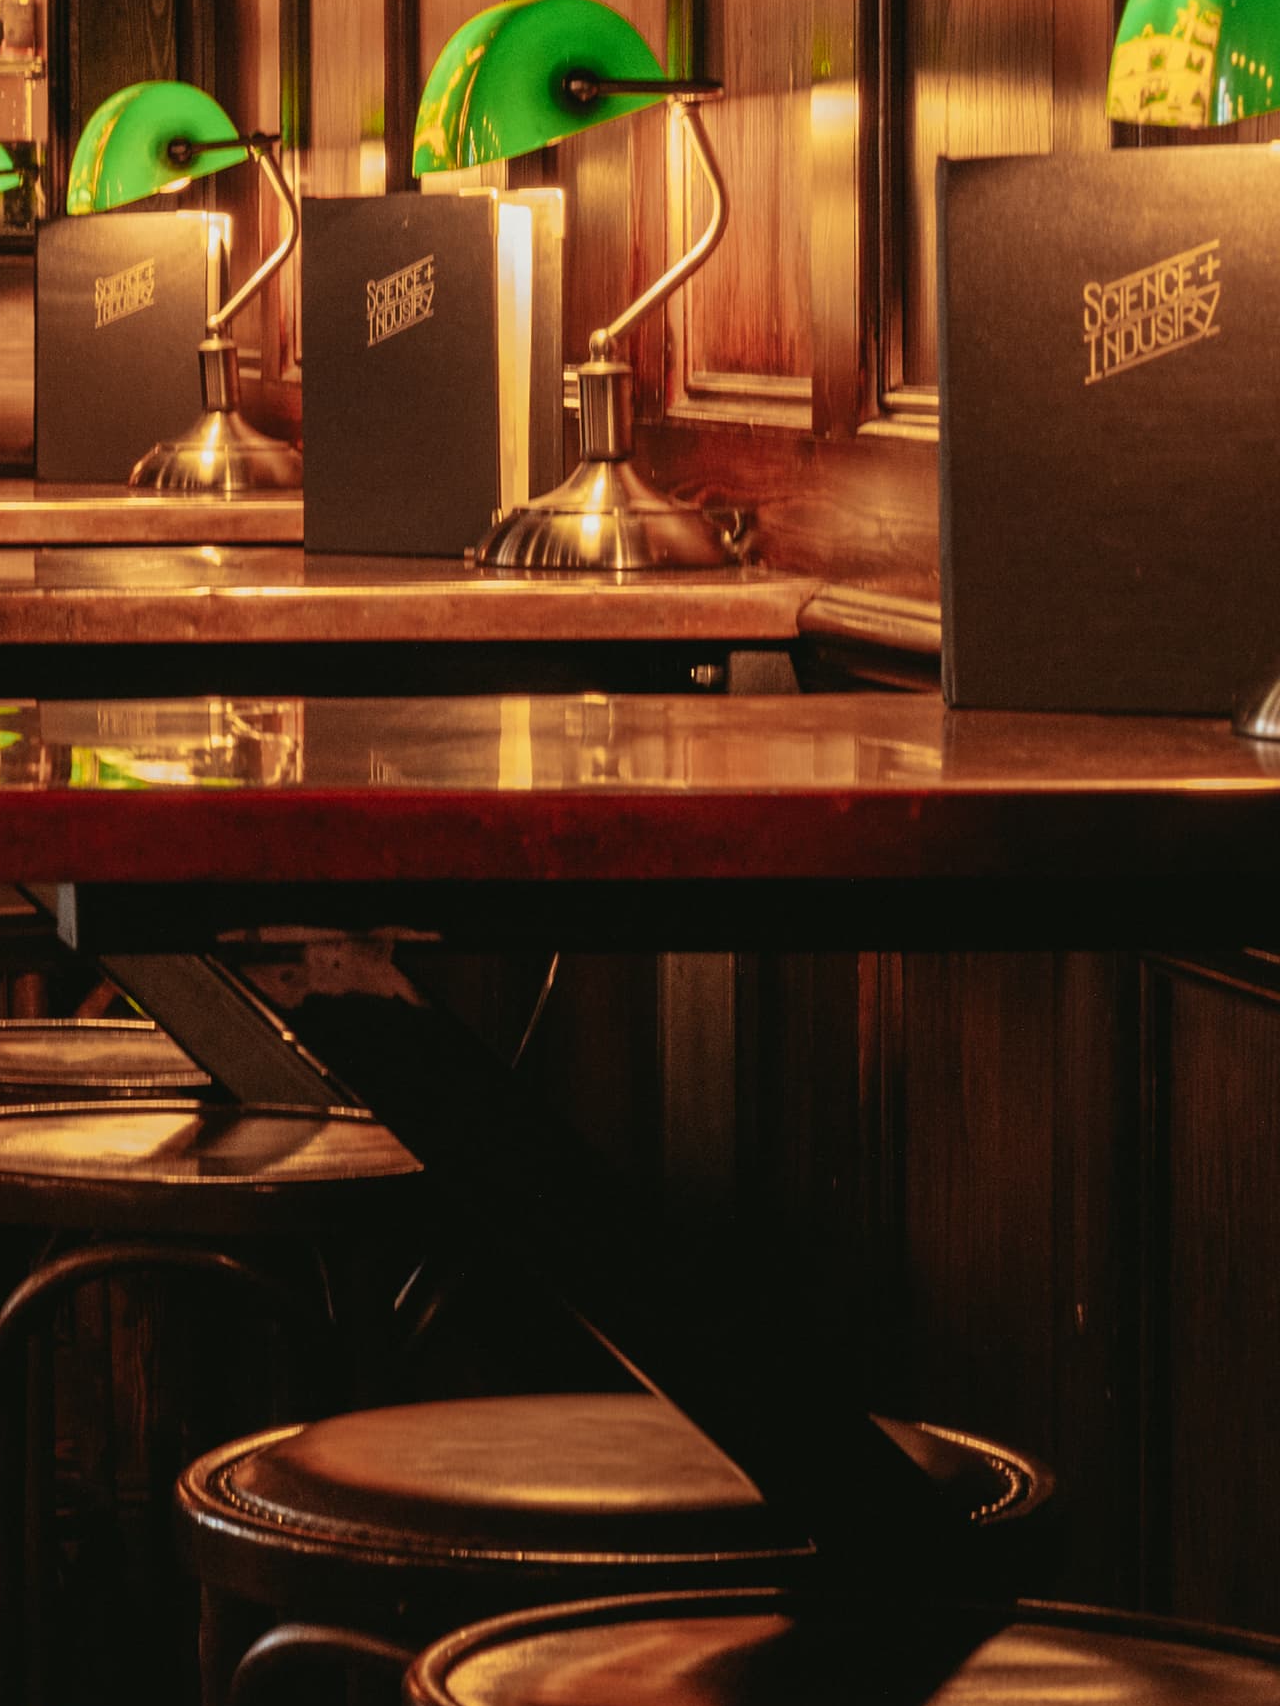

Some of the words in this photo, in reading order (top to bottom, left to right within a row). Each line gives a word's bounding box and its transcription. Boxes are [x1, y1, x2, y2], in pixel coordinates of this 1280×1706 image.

[366, 266, 423, 313] SCIENCE
[366, 281, 435, 348] INDUSTRY
[1083, 258, 1196, 334] SCIENCE
[1083, 281, 1221, 385] INDUSTRY
